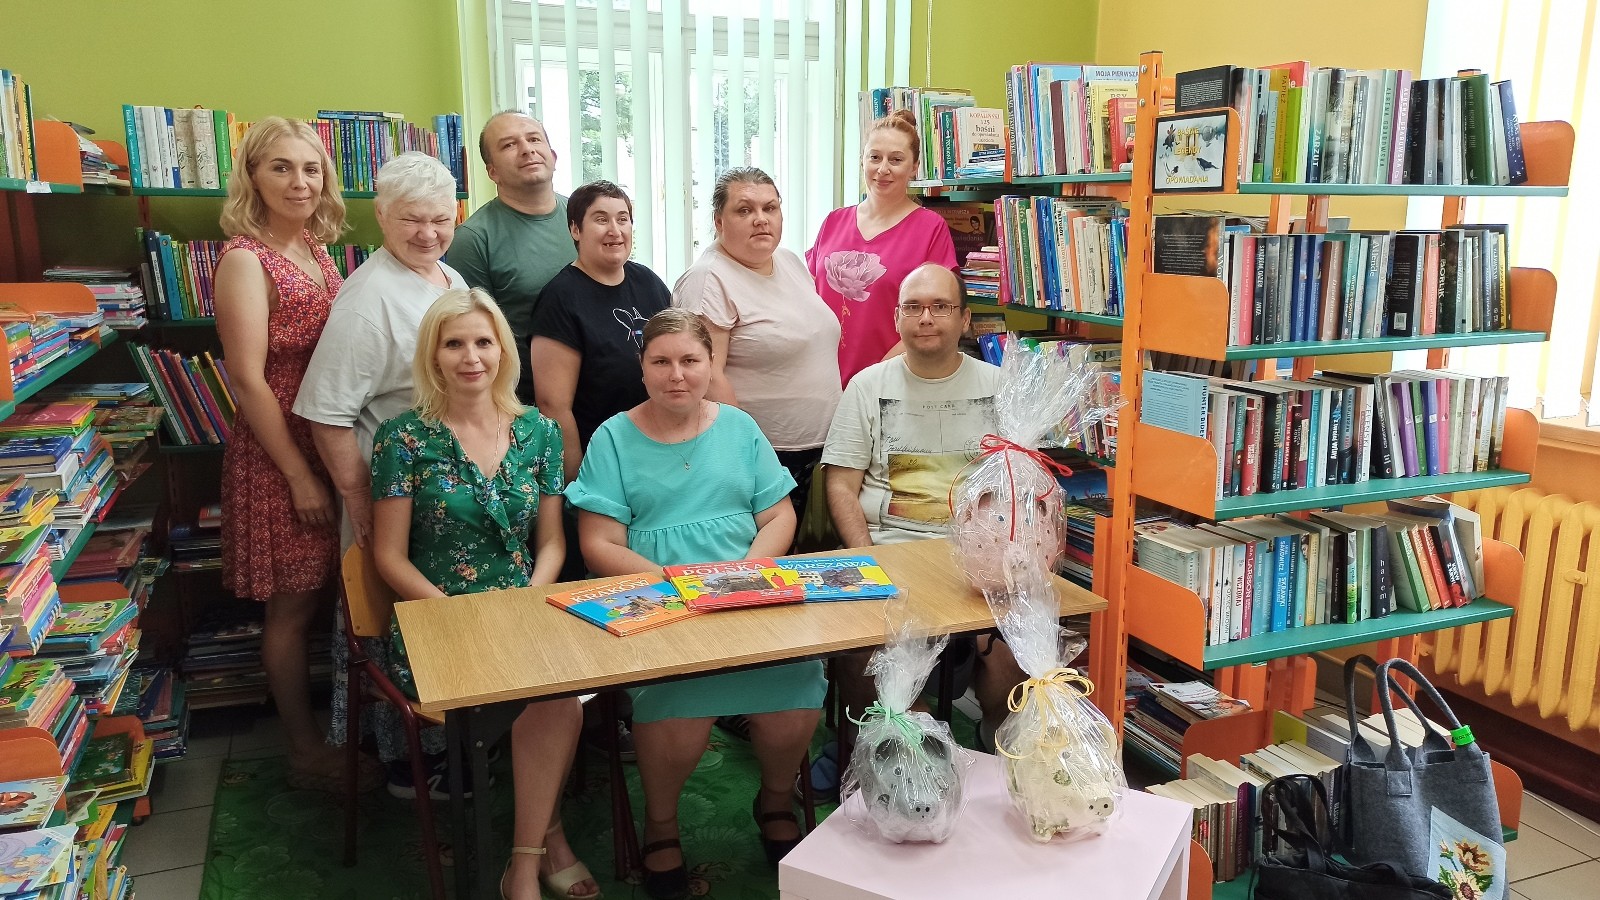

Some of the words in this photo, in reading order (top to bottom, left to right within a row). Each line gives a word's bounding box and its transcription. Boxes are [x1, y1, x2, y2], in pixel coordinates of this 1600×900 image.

[975, 125, 995, 133] baśni
[1312, 129, 1321, 167] ZARZUT
[1370, 241, 1379, 277] Allende
[681, 563, 767, 576] POLSKA
[778, 561, 871, 570] WARSZAWA
[569, 578, 650, 603] KRAKÓW
[1379, 560, 1387, 600] harem
